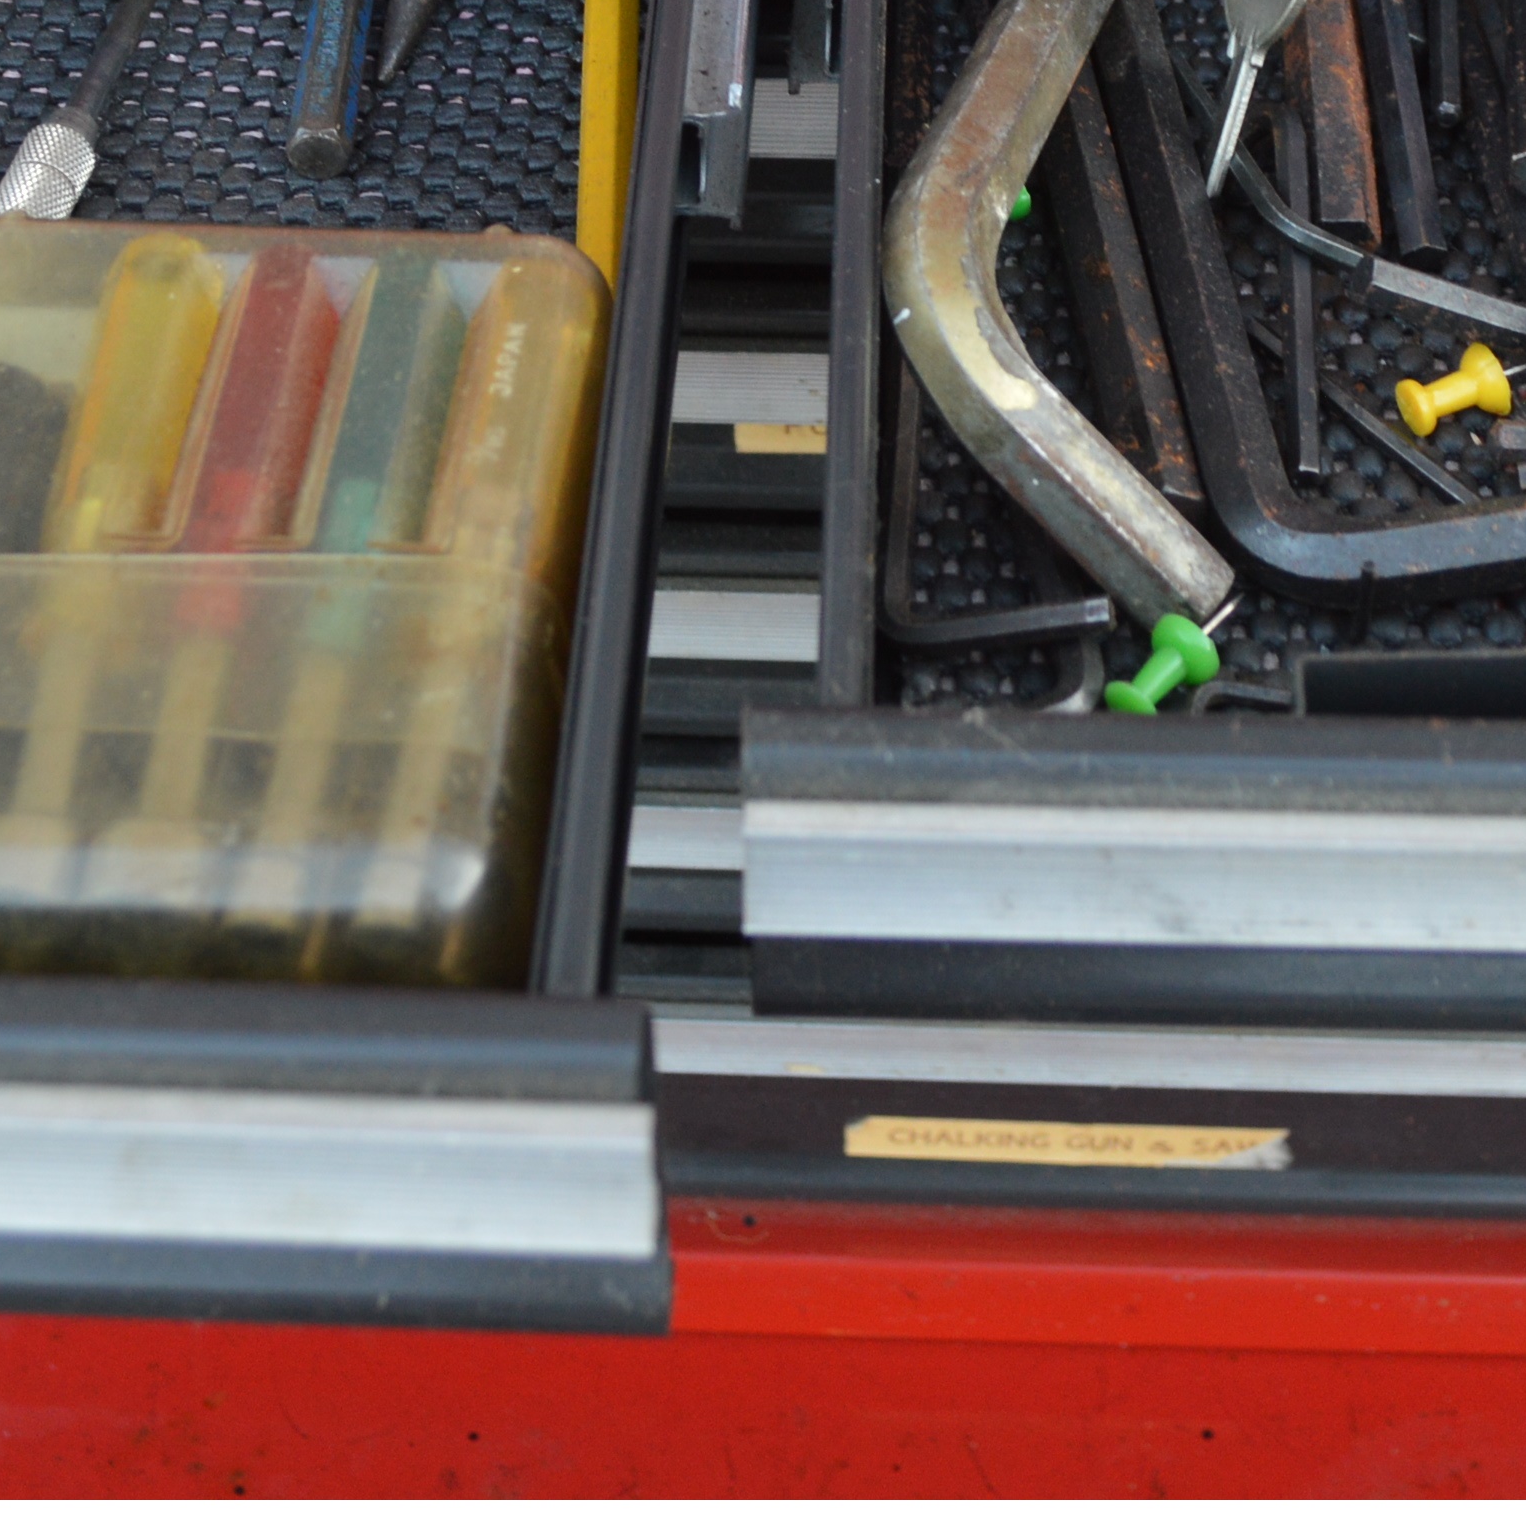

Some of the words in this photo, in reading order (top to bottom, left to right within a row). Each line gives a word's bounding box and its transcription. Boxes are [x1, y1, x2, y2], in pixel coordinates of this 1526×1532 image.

[488, 322, 528, 398] JAPAN
[887, 1126, 1051, 1151] CHALKING
[1065, 1131, 1133, 1153] GUN
